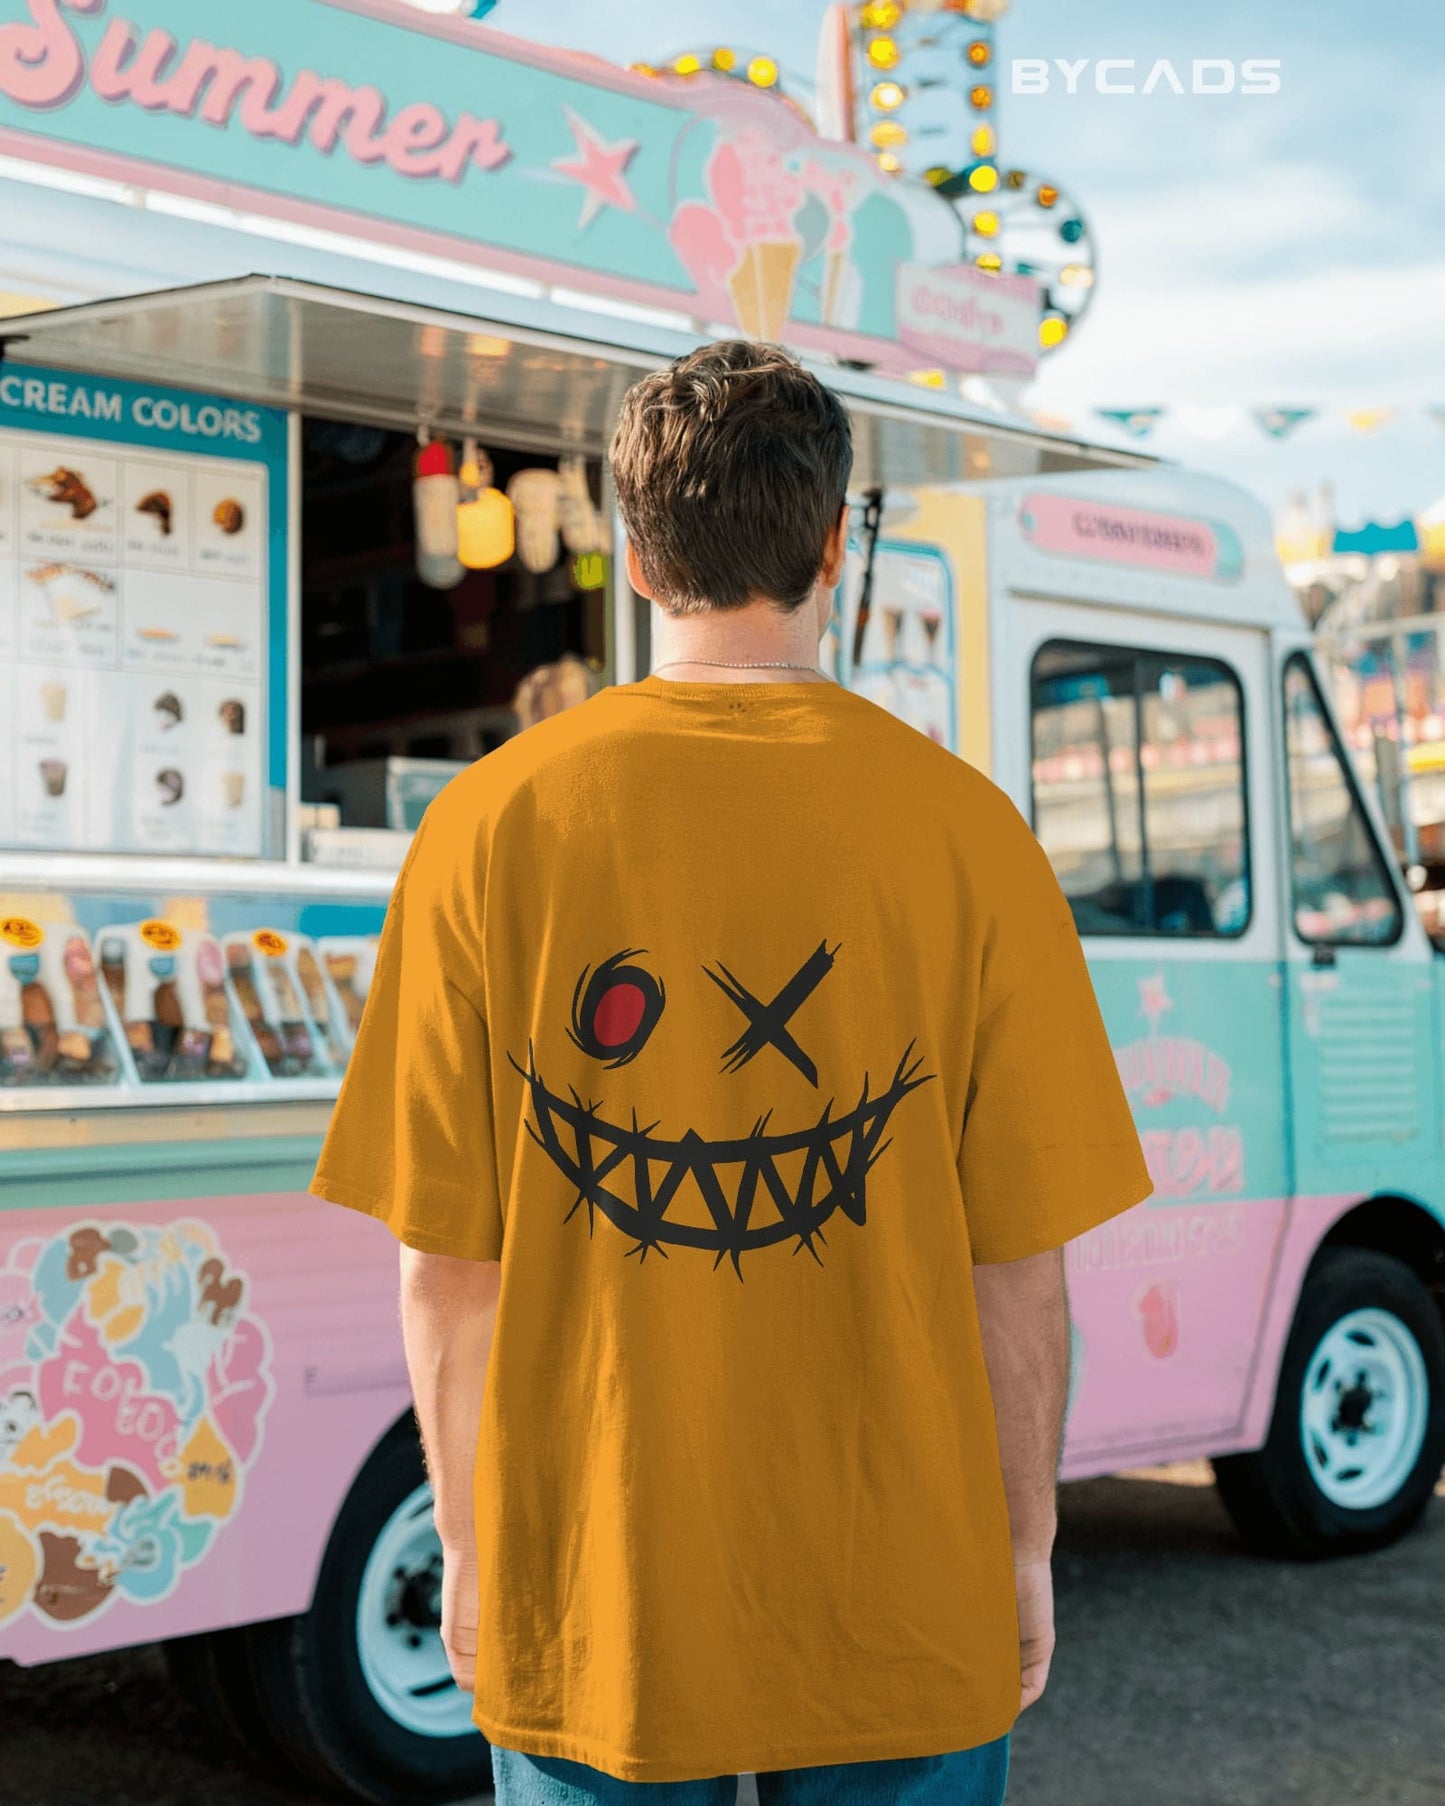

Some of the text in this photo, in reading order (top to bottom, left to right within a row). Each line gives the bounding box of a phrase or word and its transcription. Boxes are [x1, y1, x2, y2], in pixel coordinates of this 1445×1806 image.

[0, 0, 513, 185] Summer
[0, 375, 262, 443] CREAM COLORS
